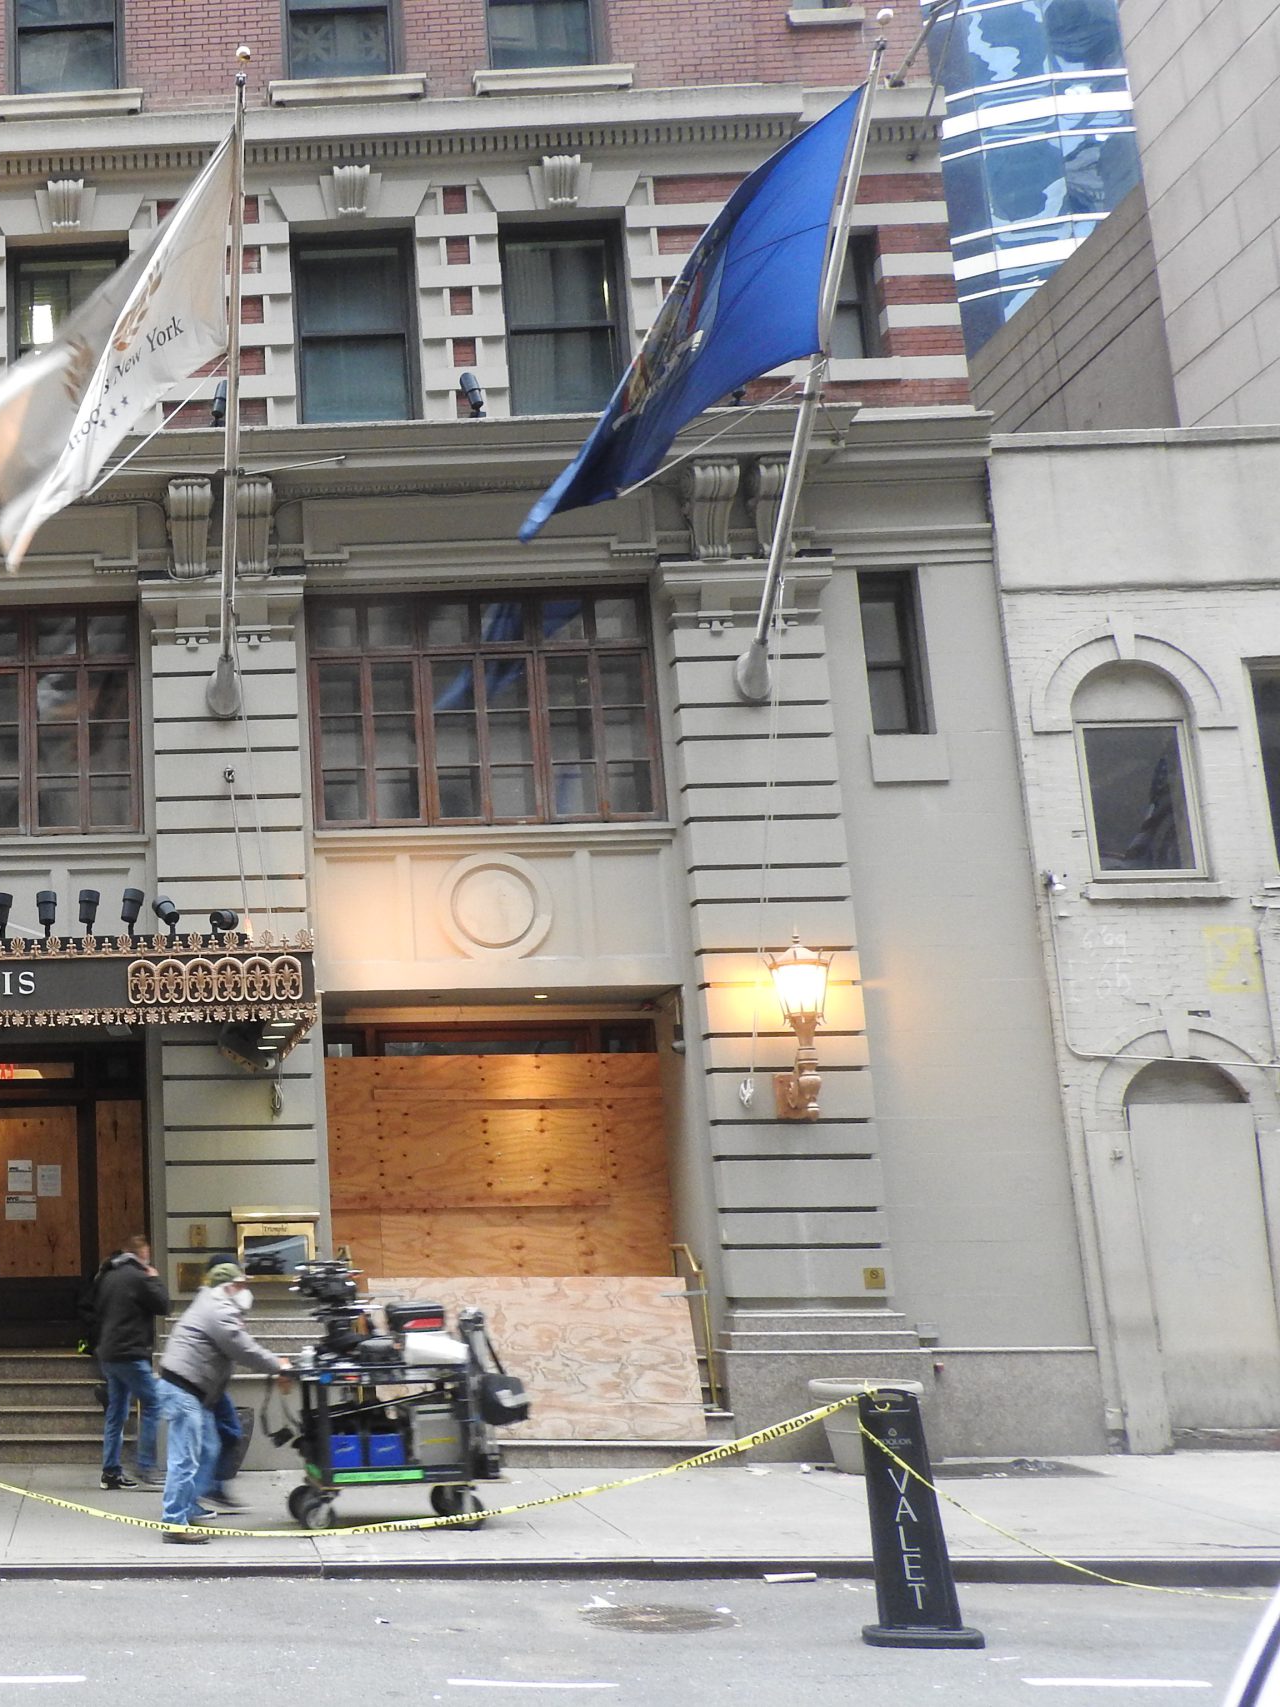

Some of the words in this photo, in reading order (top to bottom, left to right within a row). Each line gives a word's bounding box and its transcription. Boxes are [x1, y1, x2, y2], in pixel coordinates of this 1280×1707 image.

[146, 316, 184, 352] York
[751, 1415, 815, 1446] CAUTION
[675, 1444, 739, 1471] CAUTION
[103, 1513, 171, 1531] CAUTION
[887, 1467, 926, 1610] VALET
